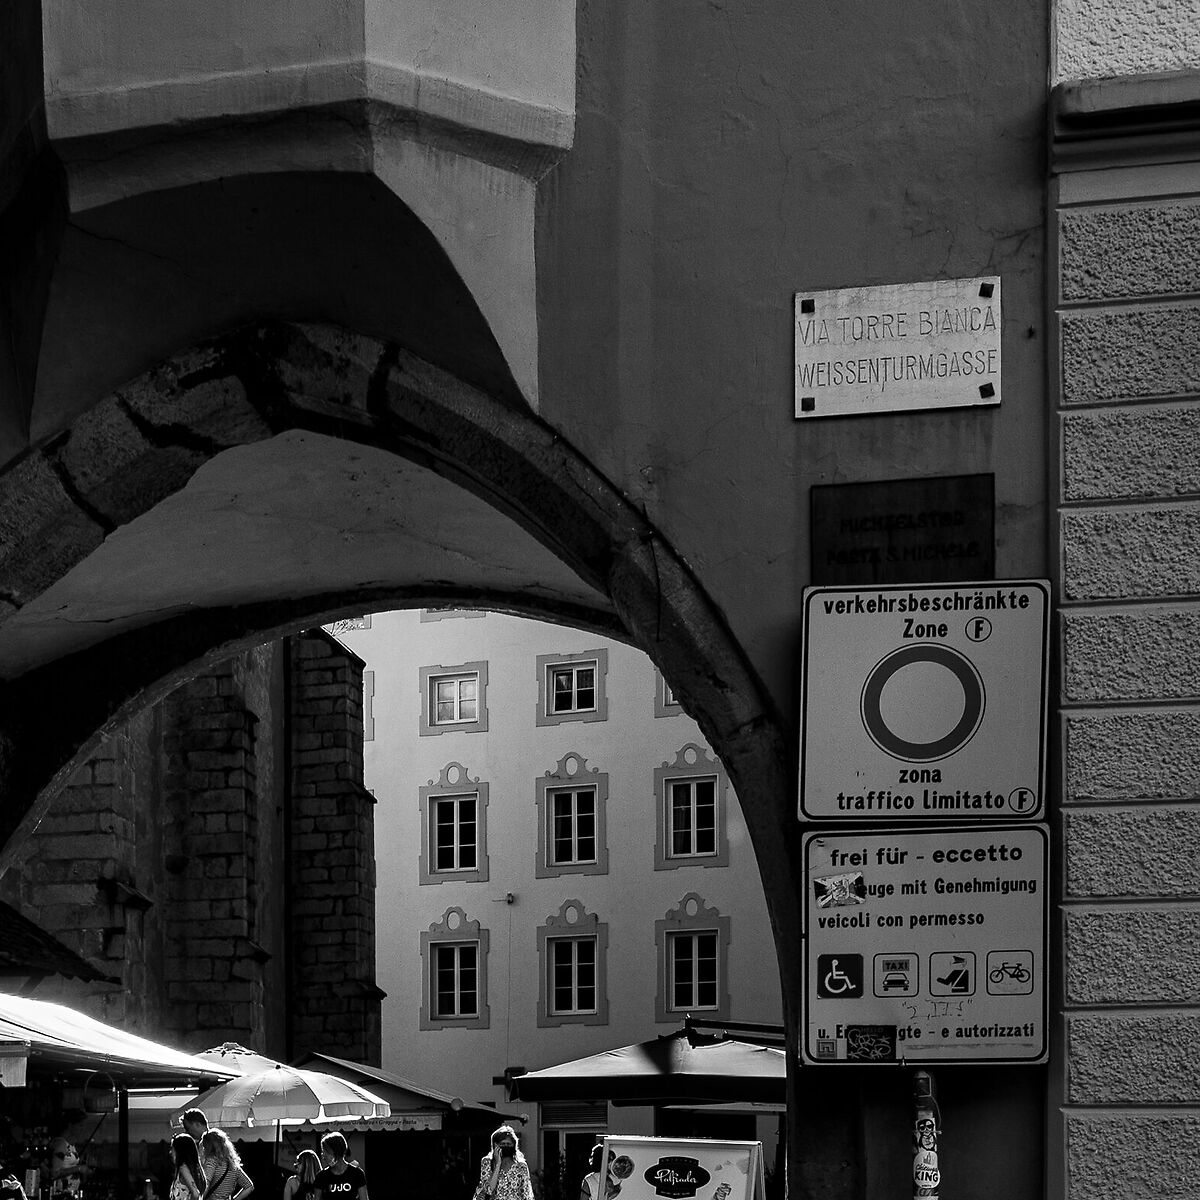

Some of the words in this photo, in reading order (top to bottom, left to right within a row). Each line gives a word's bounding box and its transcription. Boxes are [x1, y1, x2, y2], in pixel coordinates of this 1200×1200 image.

[798, 316, 830, 346] VIA
[837, 312, 907, 342] TORRE
[919, 305, 997, 336] BIANCA
[798, 349, 997, 389] WEISSENTURMGASSE
[823, 591, 1030, 614] verkehrsbeschränkte
[902, 618, 949, 639] Zone
[899, 768, 942, 784] zona
[837, 791, 915, 810] traffico
[922, 789, 1005, 810] limitato
[830, 849, 868, 867] frei
[876, 847, 908, 865] für
[932, 845, 1023, 864] eccetto
[901, 879, 928, 895] mit
[934, 877, 1037, 895] Genehmigung
[818, 912, 870, 929] veicoli
[877, 915, 903, 928] con
[910, 912, 985, 930] permesso
[885, 962, 908, 971] TAXI
[941, 1027, 950, 1039] e
[955, 1022, 1034, 1038] autorizzati
[915, 1170, 938, 1183] KING
